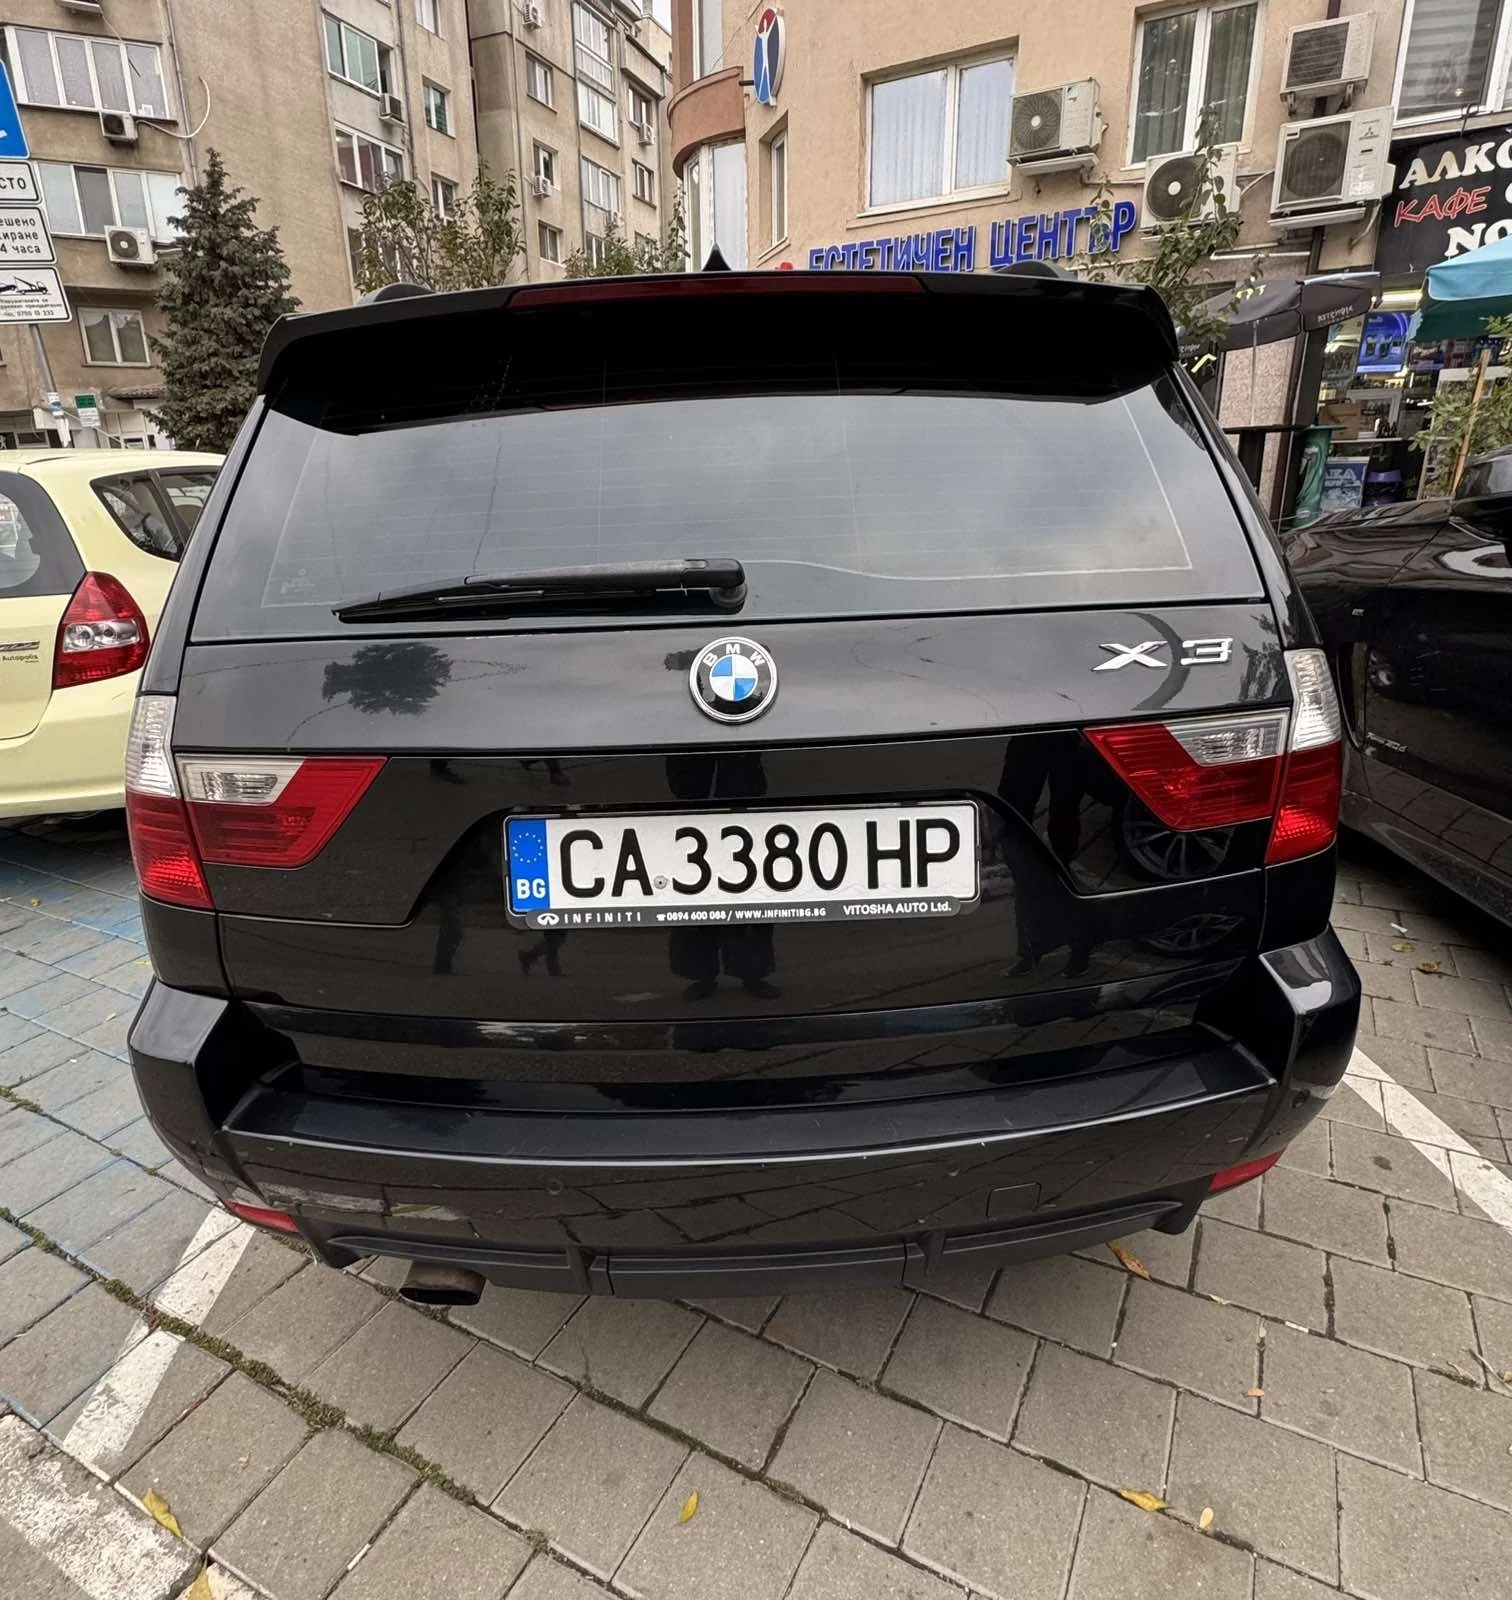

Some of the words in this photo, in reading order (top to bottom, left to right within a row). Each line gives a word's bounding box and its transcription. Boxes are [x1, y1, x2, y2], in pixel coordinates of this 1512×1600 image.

[1394, 185, 1492, 227] КАФЕ
[0, 231, 39, 242] иране
[808, 225, 977, 273] ЕСТЕТИЧЕН
[989, 200, 1137, 270] ЦЕНТЪР
[12, 245, 41, 254] часа
[703, 643, 766, 668] BMW
[1091, 638, 1233, 671] X3
[559, 828, 654, 898] CA
[671, 822, 848, 895] 3380
[866, 818, 961, 889] HP
[516, 878, 546, 899] BG
[564, 912, 641, 924] INFINITI
[667, 911, 689, 921] 0894
[691, 911, 707, 920] 600
[735, 908, 826, 919] WWW.INFINITIBG.BG
[843, 903, 894, 916] VITOSHA
[896, 902, 928, 914] AUTO
[931, 901, 952, 912] Ltd.
